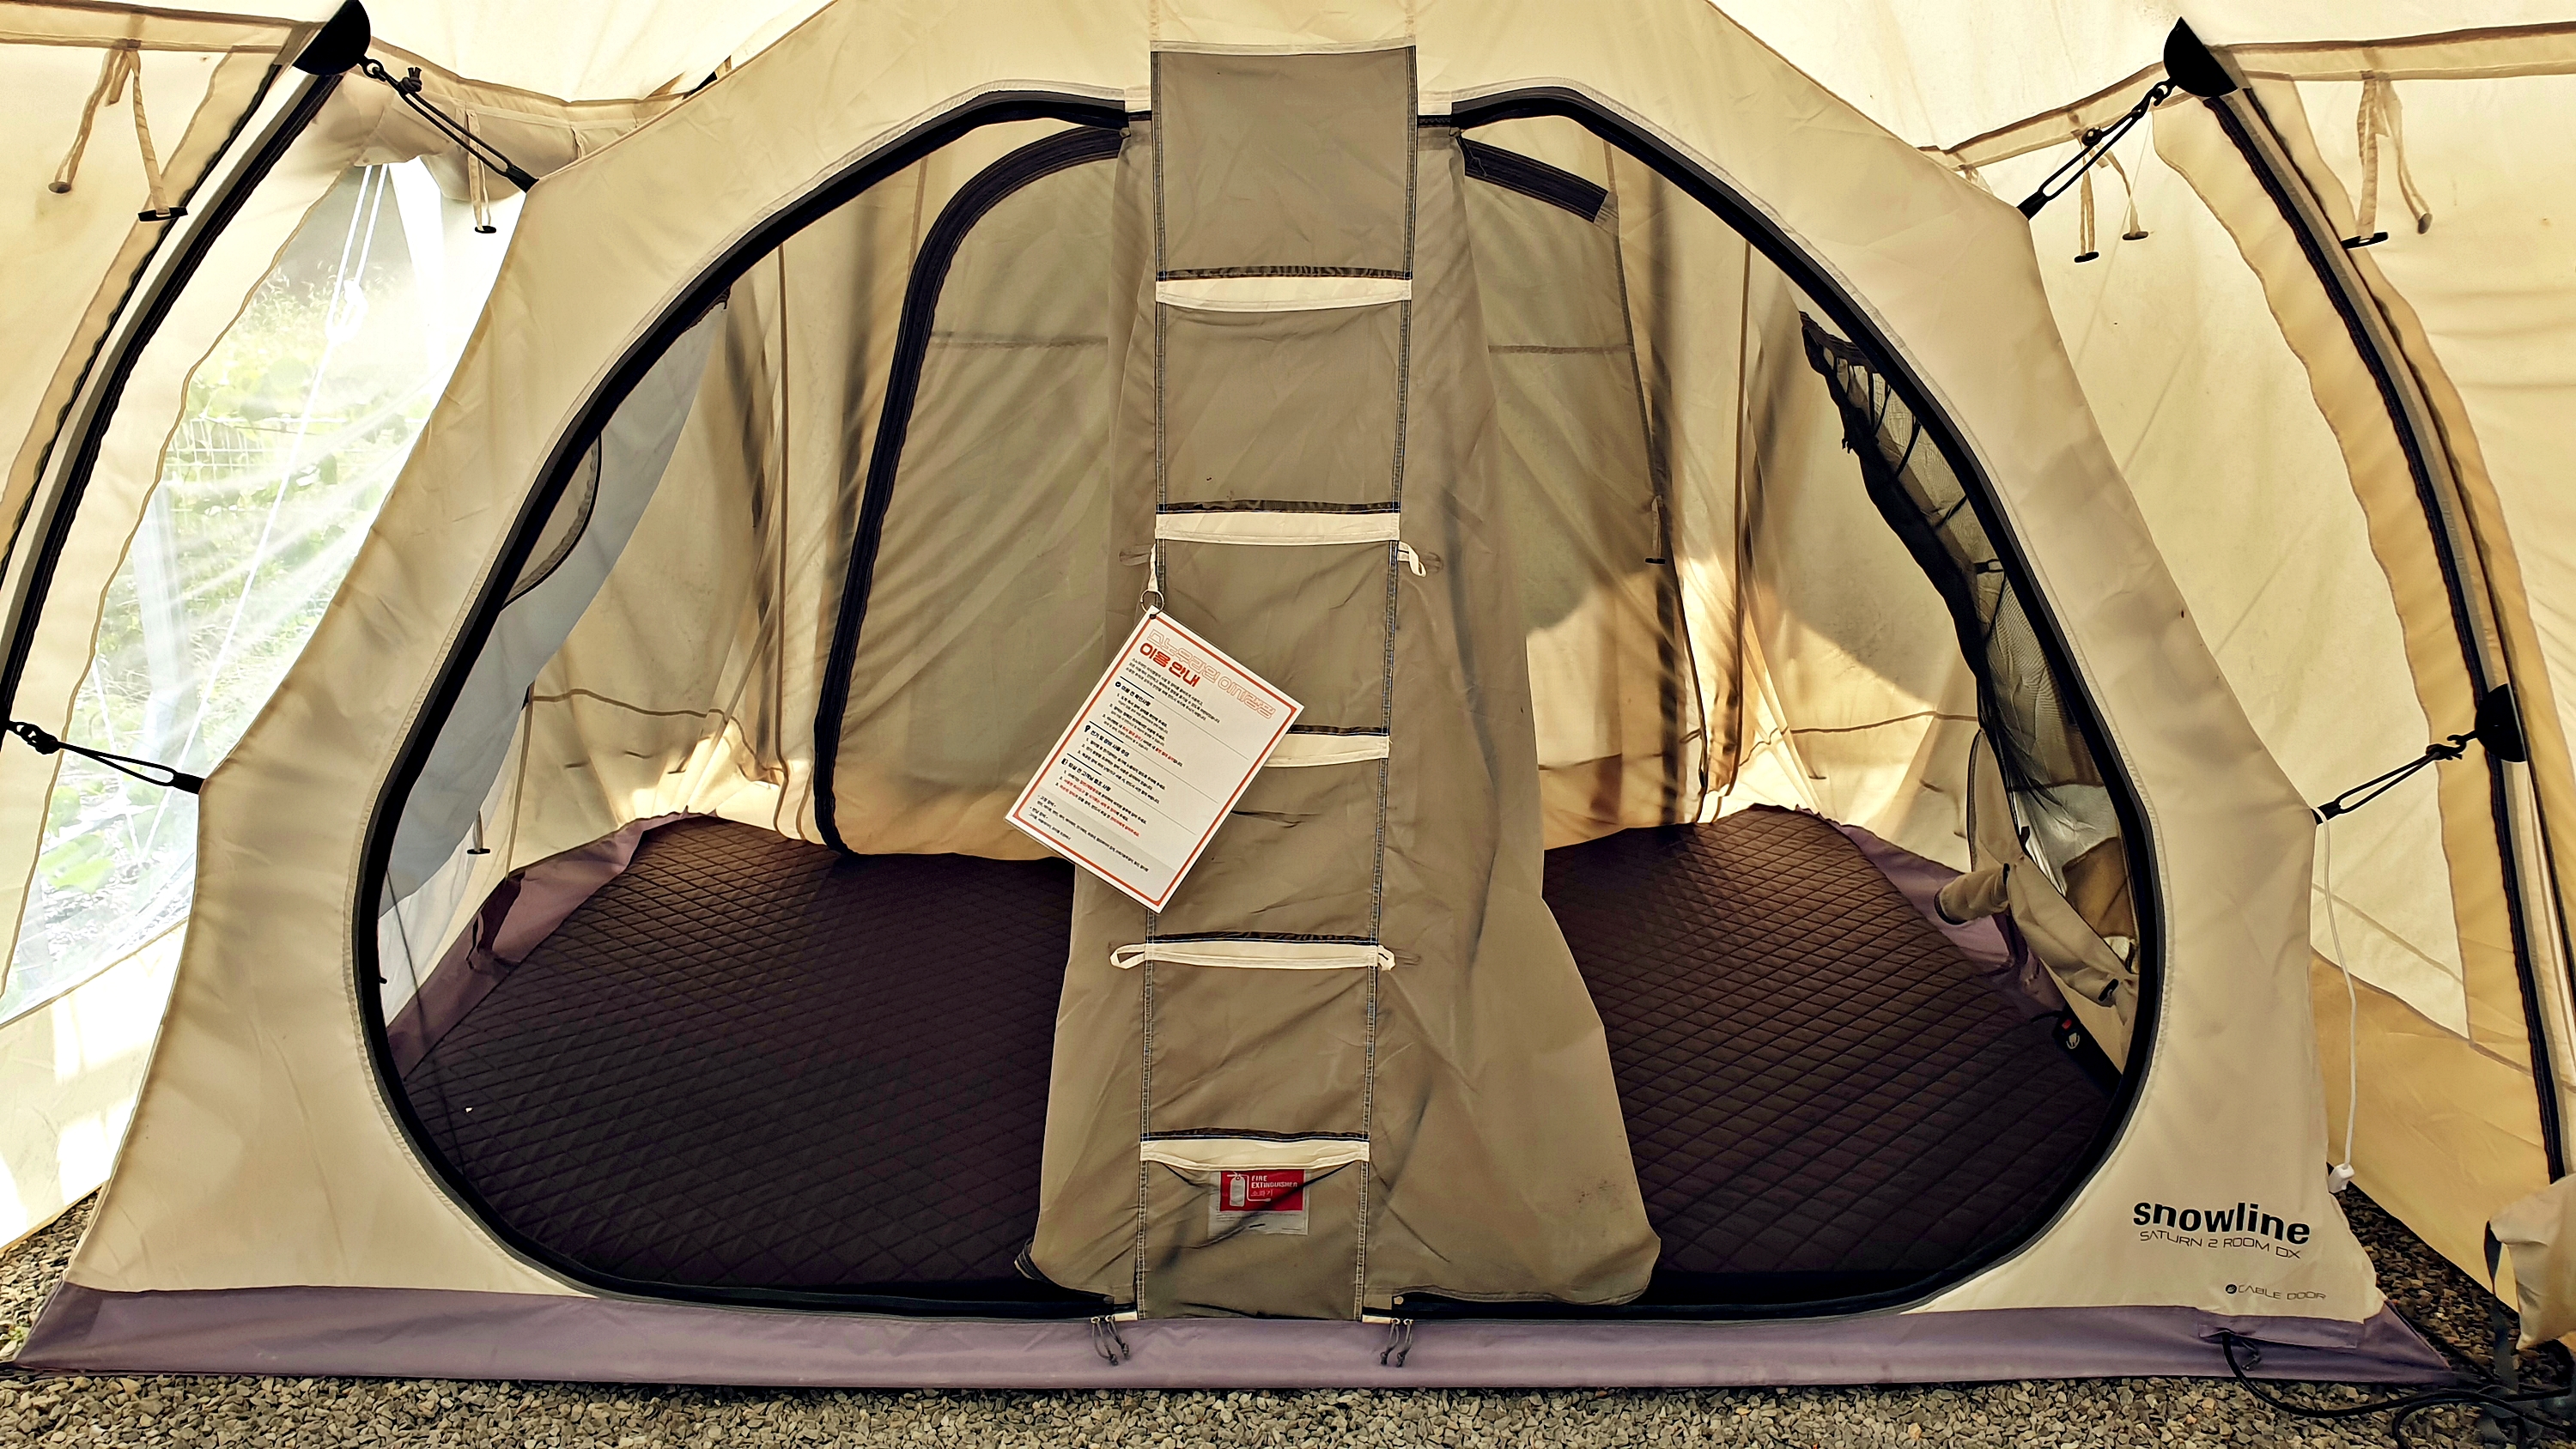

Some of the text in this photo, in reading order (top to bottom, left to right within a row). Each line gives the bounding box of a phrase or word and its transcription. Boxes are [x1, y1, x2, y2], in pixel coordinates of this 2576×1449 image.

[1139, 642, 1200, 687] 이용 안내
[1146, 628, 1276, 718] 스노우라인 이지캠핑
[2133, 1202, 2311, 1245] snowline
[2140, 1230, 2300, 1258] SATURN 2 ROOM DX
[2239, 1285, 2326, 1300] CABLE DOOR
